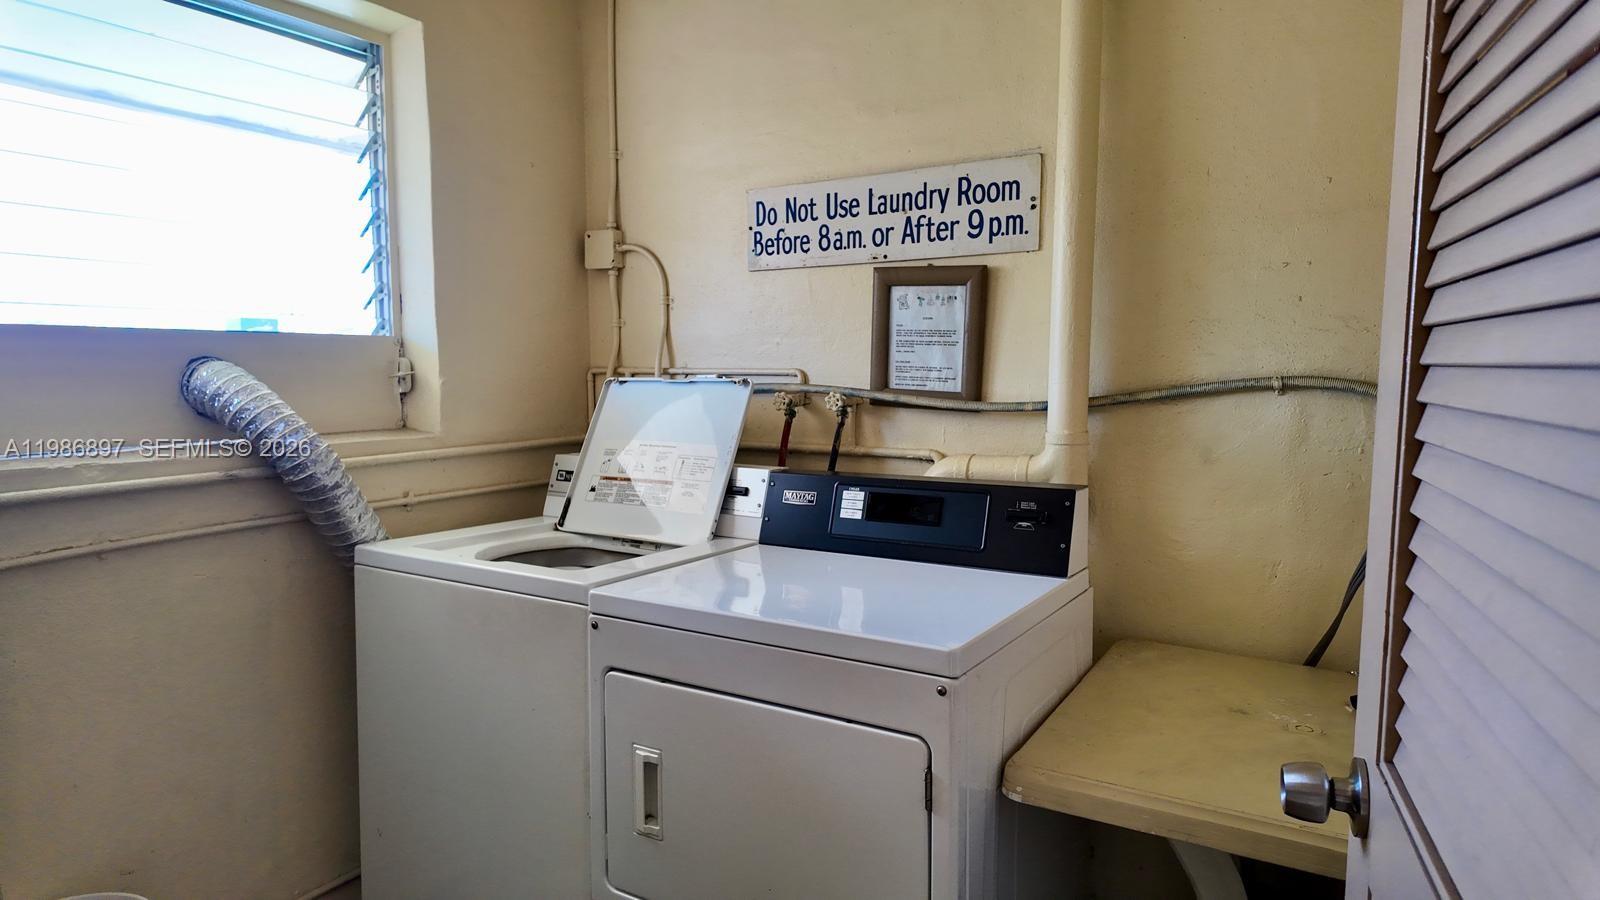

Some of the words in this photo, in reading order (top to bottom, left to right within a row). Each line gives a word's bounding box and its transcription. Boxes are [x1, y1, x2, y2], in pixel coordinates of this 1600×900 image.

[755, 200, 778, 227] Do
[785, 196, 818, 224] Not
[825, 192, 860, 220] Use
[868, 182, 950, 214] Laundry
[957, 176, 1021, 207] Room
[753, 228, 811, 257] Before
[872, 225, 895, 248] or
[901, 214, 960, 245] After
[784, 491, 815, 501] MAYTAG
